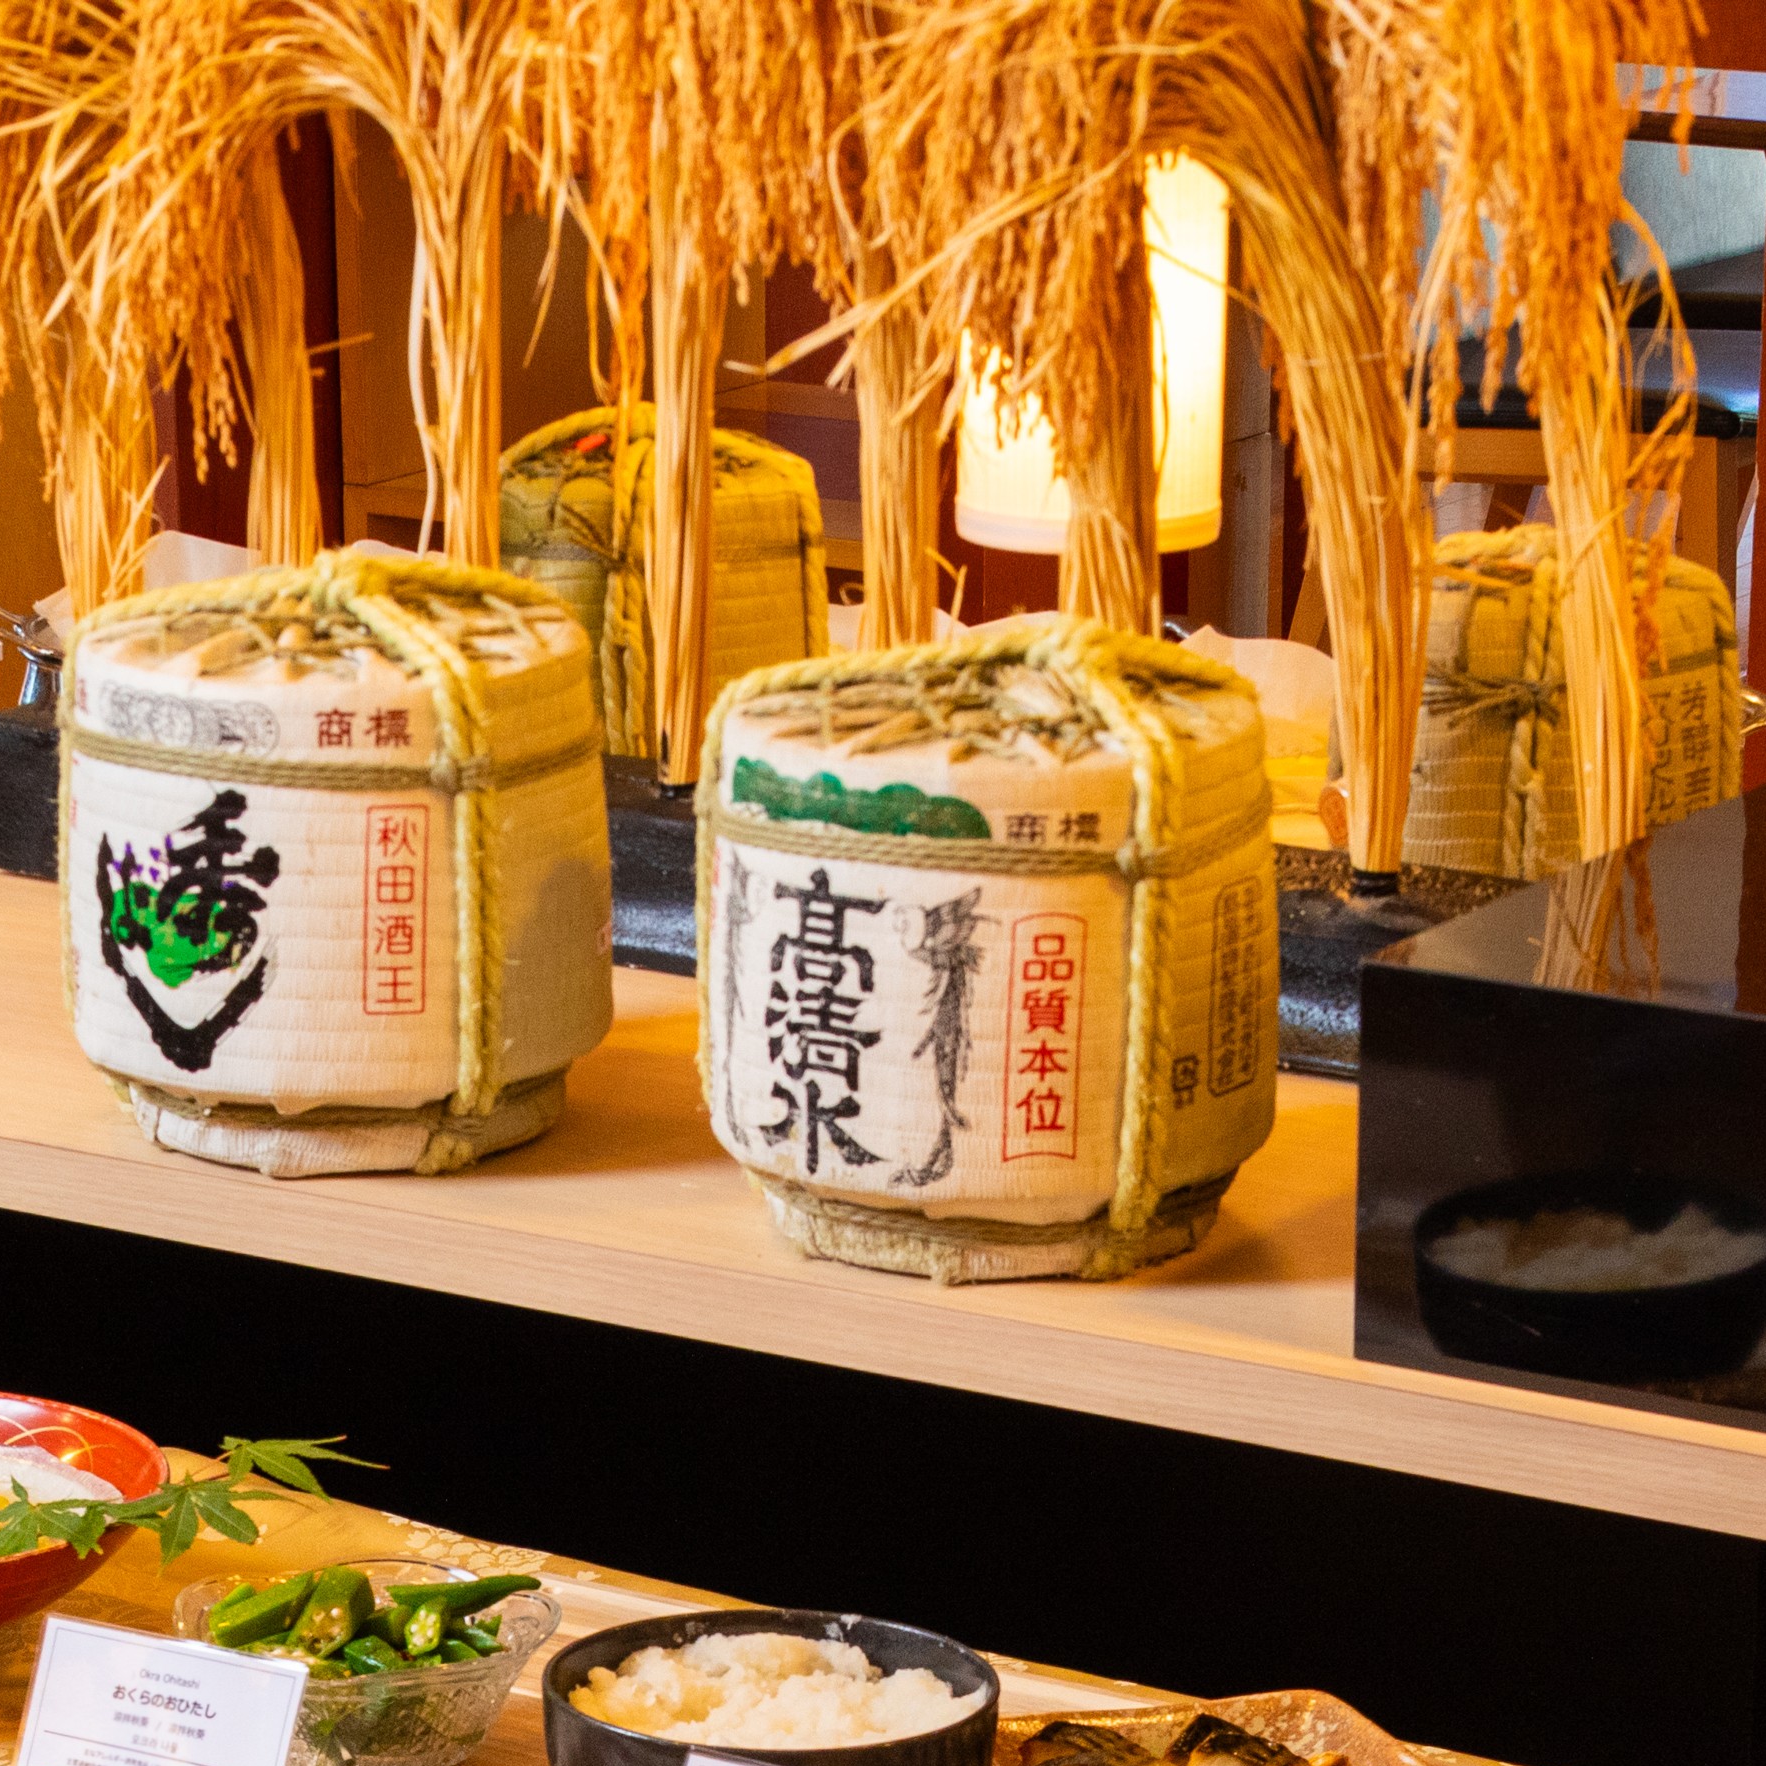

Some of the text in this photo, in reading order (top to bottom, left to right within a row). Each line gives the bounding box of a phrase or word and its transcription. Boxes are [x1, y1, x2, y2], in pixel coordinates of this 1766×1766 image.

[315, 707, 413, 748] 商標
[375, 815, 419, 1005] 秋田酒王
[1016, 933, 1075, 1135] 品質本位
[112, 1685, 215, 1718] おくらのおひたし
